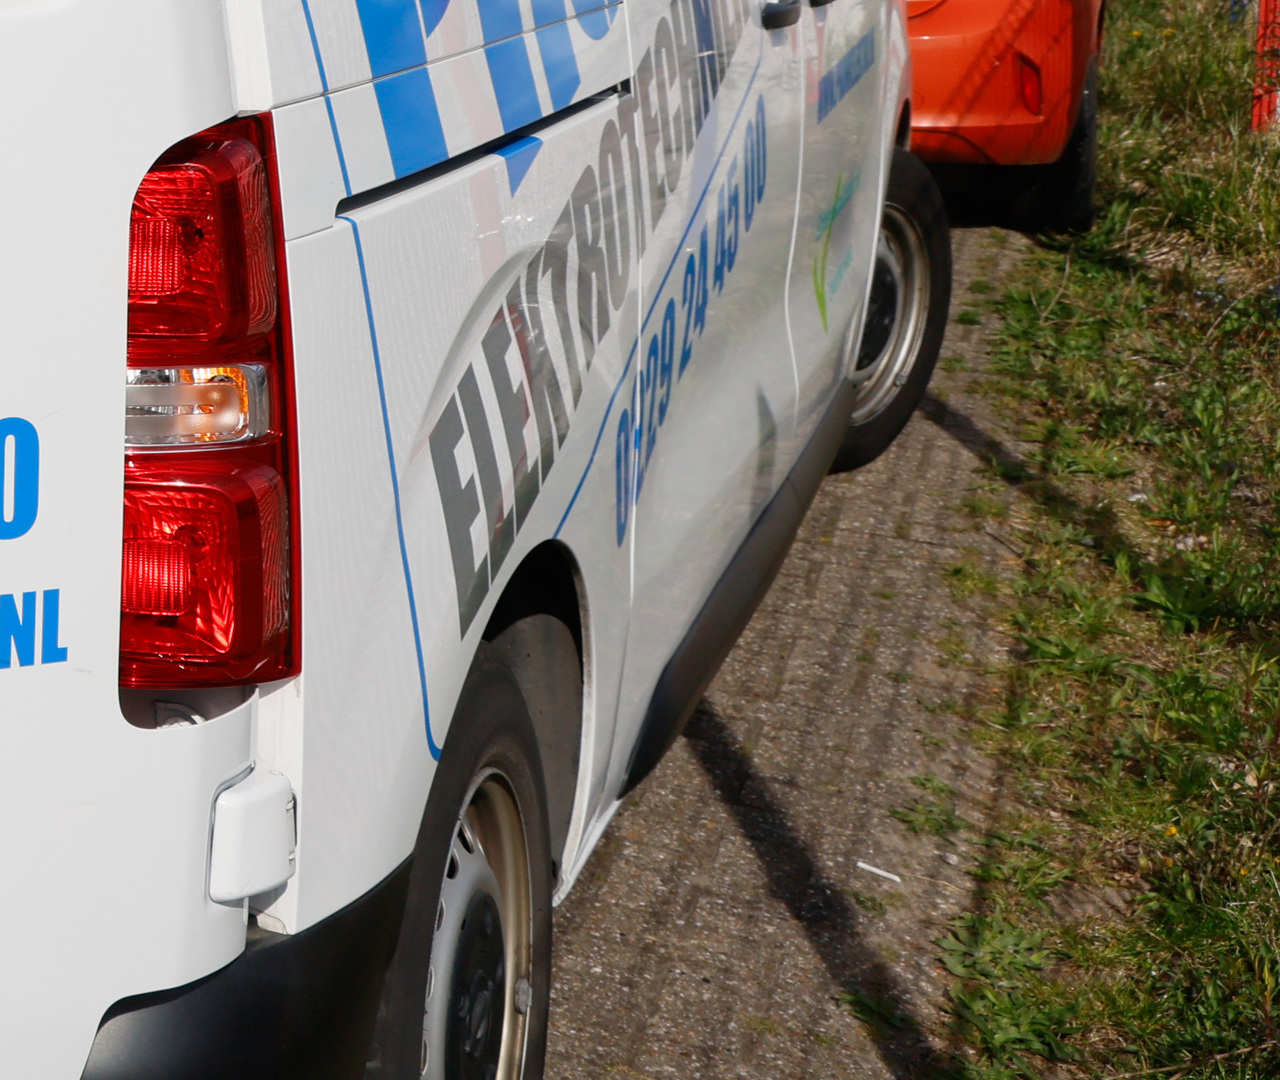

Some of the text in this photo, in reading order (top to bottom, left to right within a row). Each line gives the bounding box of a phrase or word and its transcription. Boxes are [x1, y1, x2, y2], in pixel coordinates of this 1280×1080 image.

[678, 218, 709, 382] 24
[713, 152, 739, 296] 45
[744, 93, 768, 233] 00
